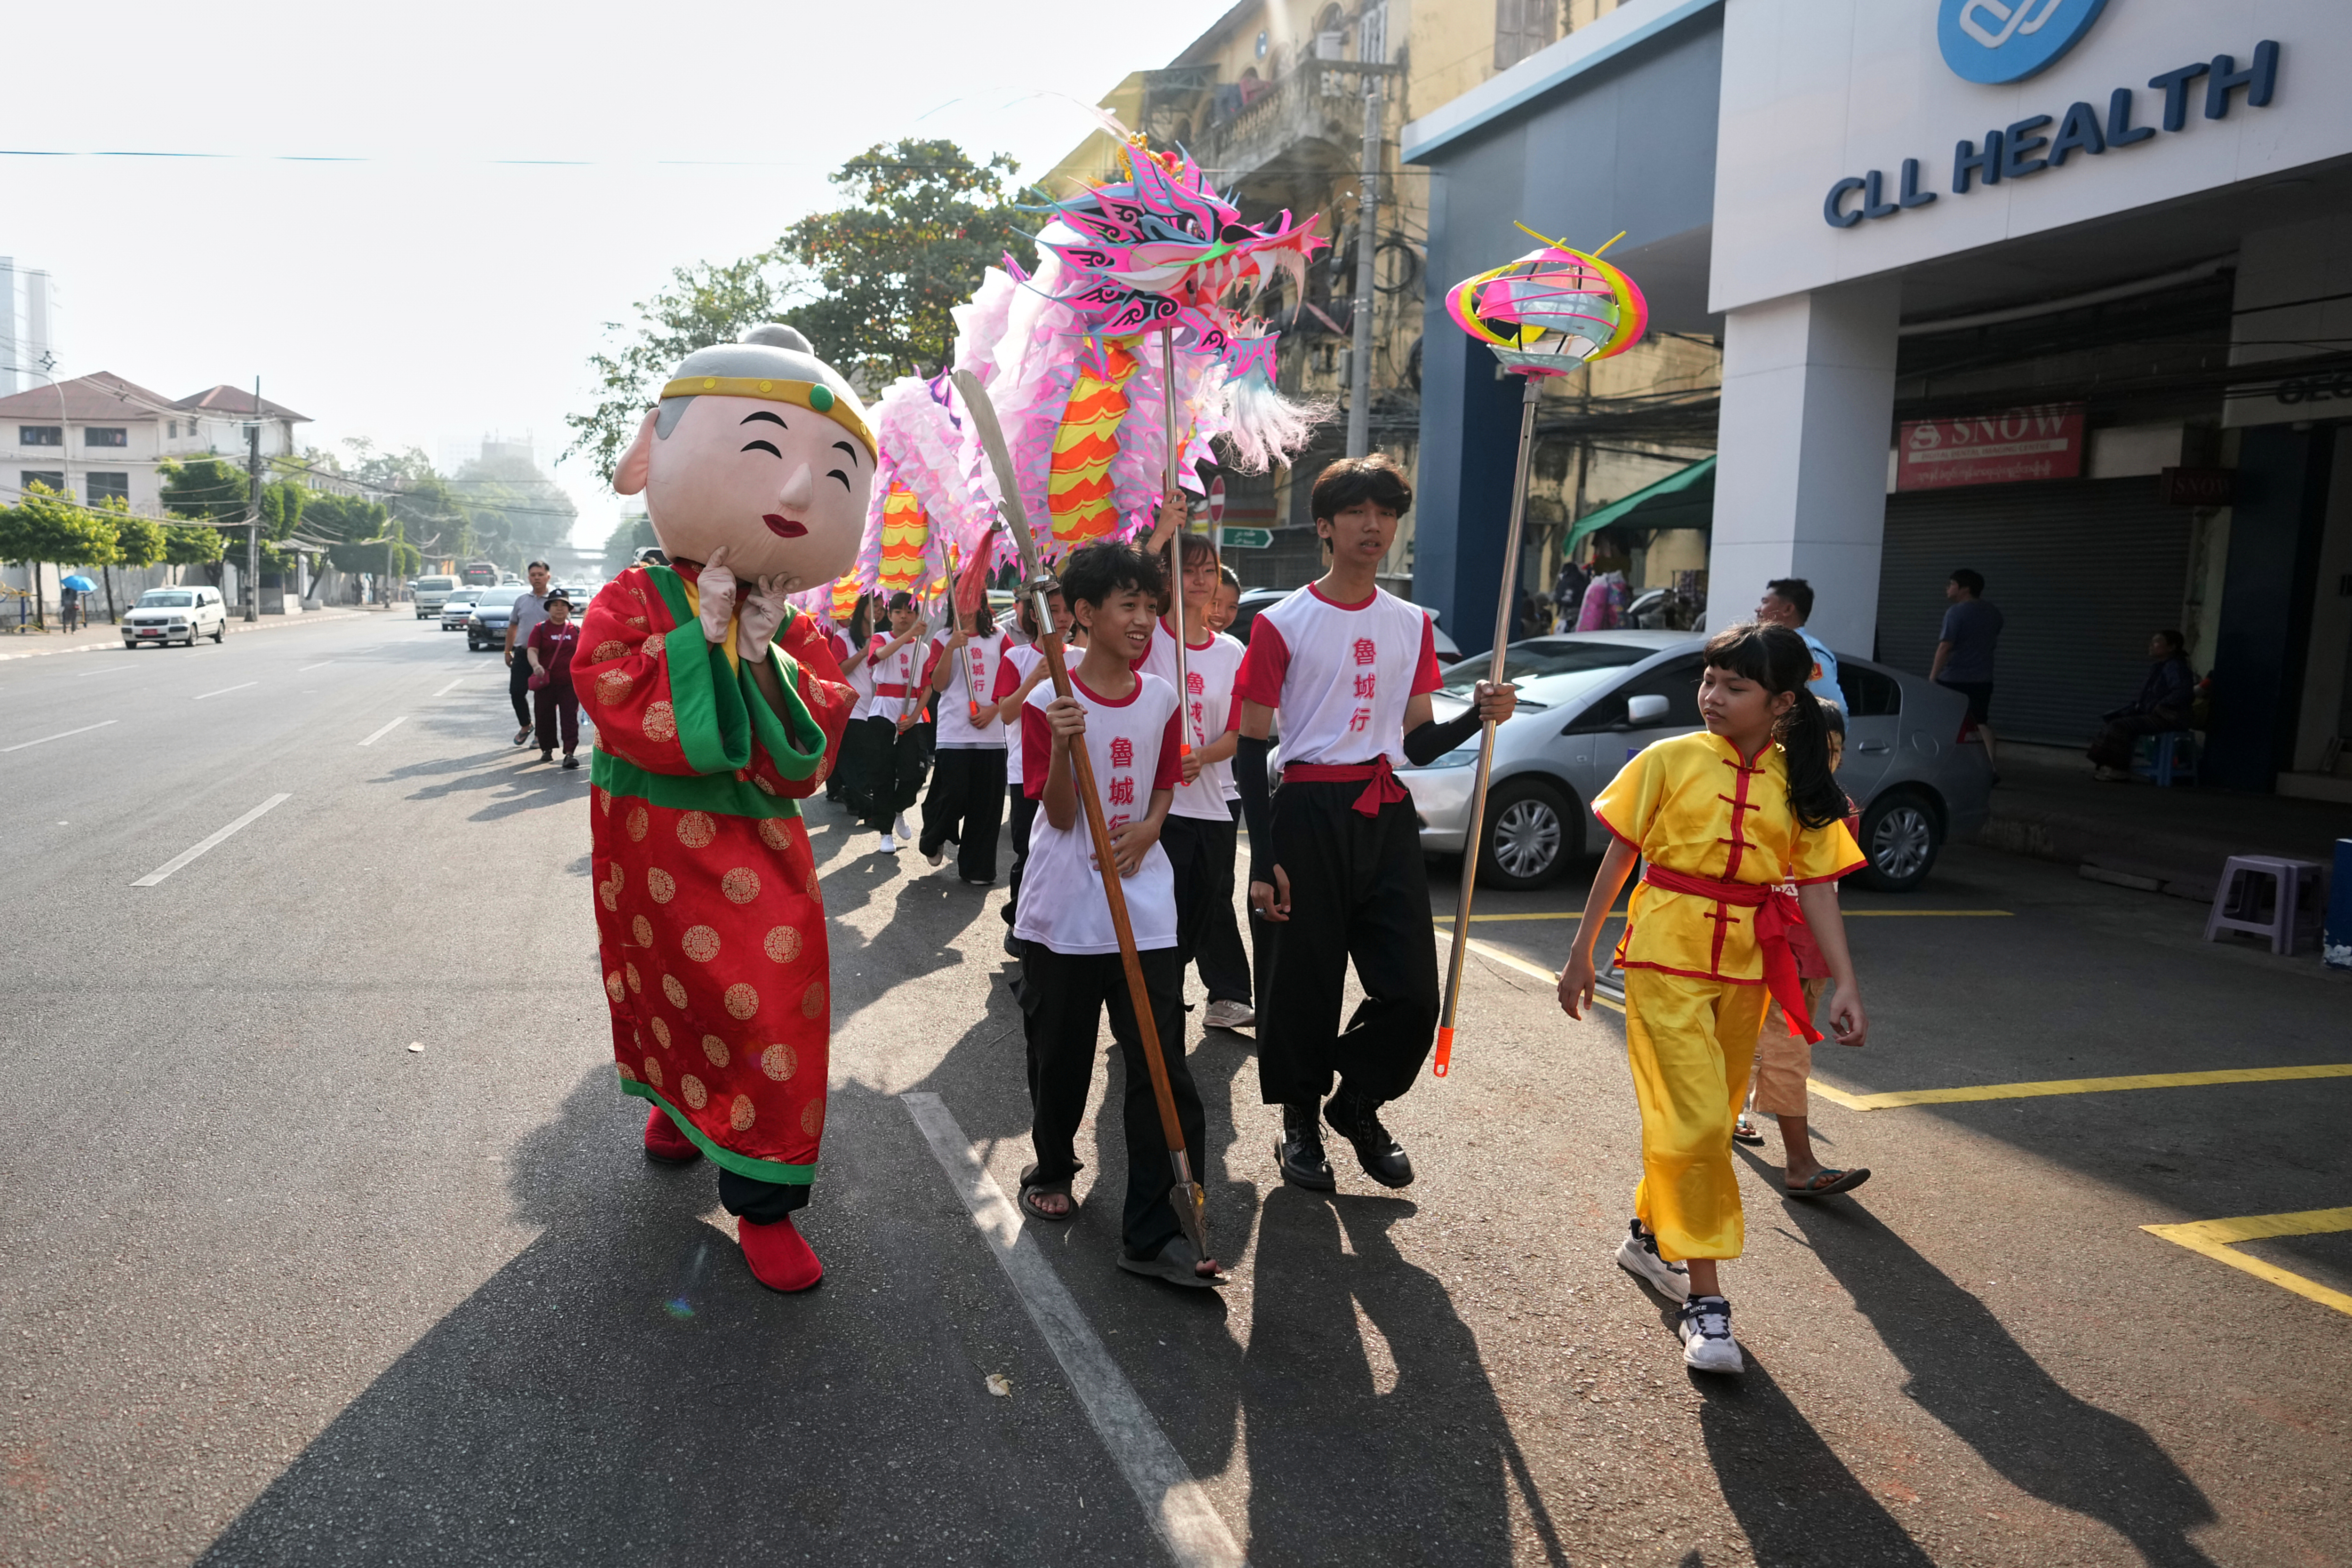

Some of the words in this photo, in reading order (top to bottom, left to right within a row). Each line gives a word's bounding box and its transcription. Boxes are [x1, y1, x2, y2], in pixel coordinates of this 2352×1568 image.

[1823, 158, 1937, 228] CLL
[1952, 40, 2279, 194] HEALTH
[1952, 402, 2072, 445] SNOW
[1982, 445, 2017, 454] IMAGING
[970, 647, 985, 692] 魯城行
[1349, 637, 1376, 732] 魯城行
[1689, 1305, 1707, 1314] NIKE
